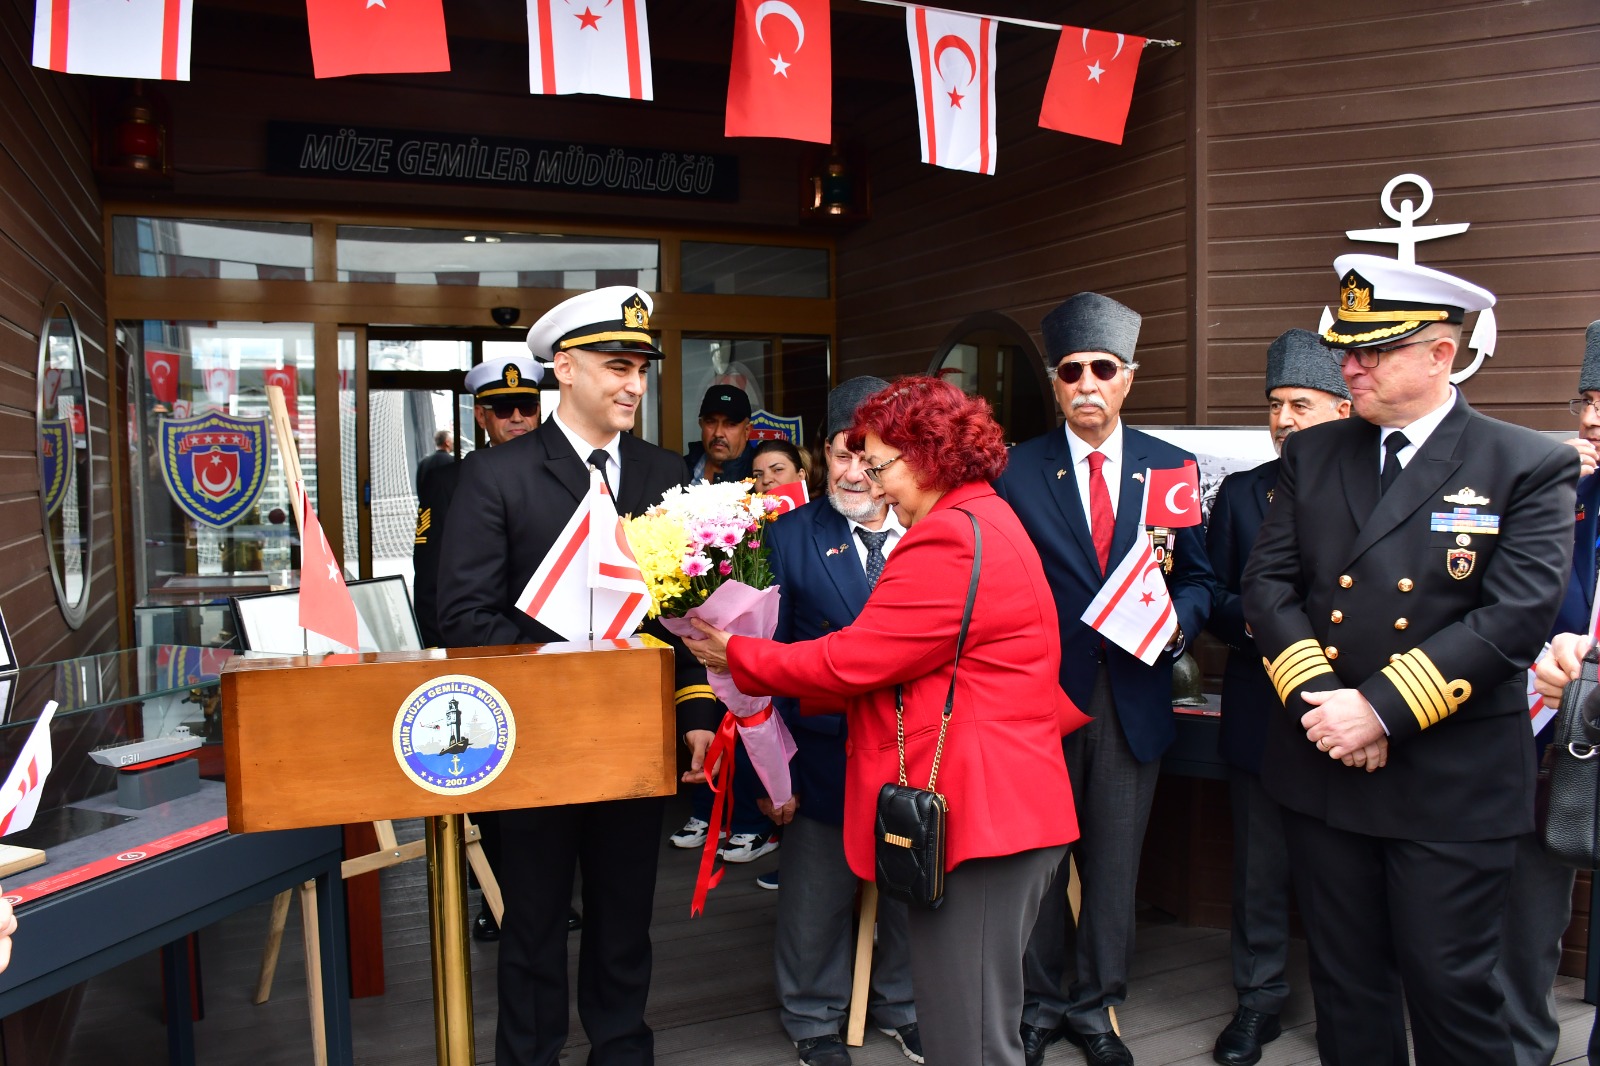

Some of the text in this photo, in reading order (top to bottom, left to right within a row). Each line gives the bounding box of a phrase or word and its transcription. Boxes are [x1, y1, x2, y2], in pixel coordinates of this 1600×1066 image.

[300, 128, 714, 194] MÜZE GEMİLER MÜDÜRLÜĞÜ
[400, 682, 508, 757] İZMİR MÜZE GEMİLER MÜDÜRLÜĞÜ
[445, 777, 468, 787] 2007
